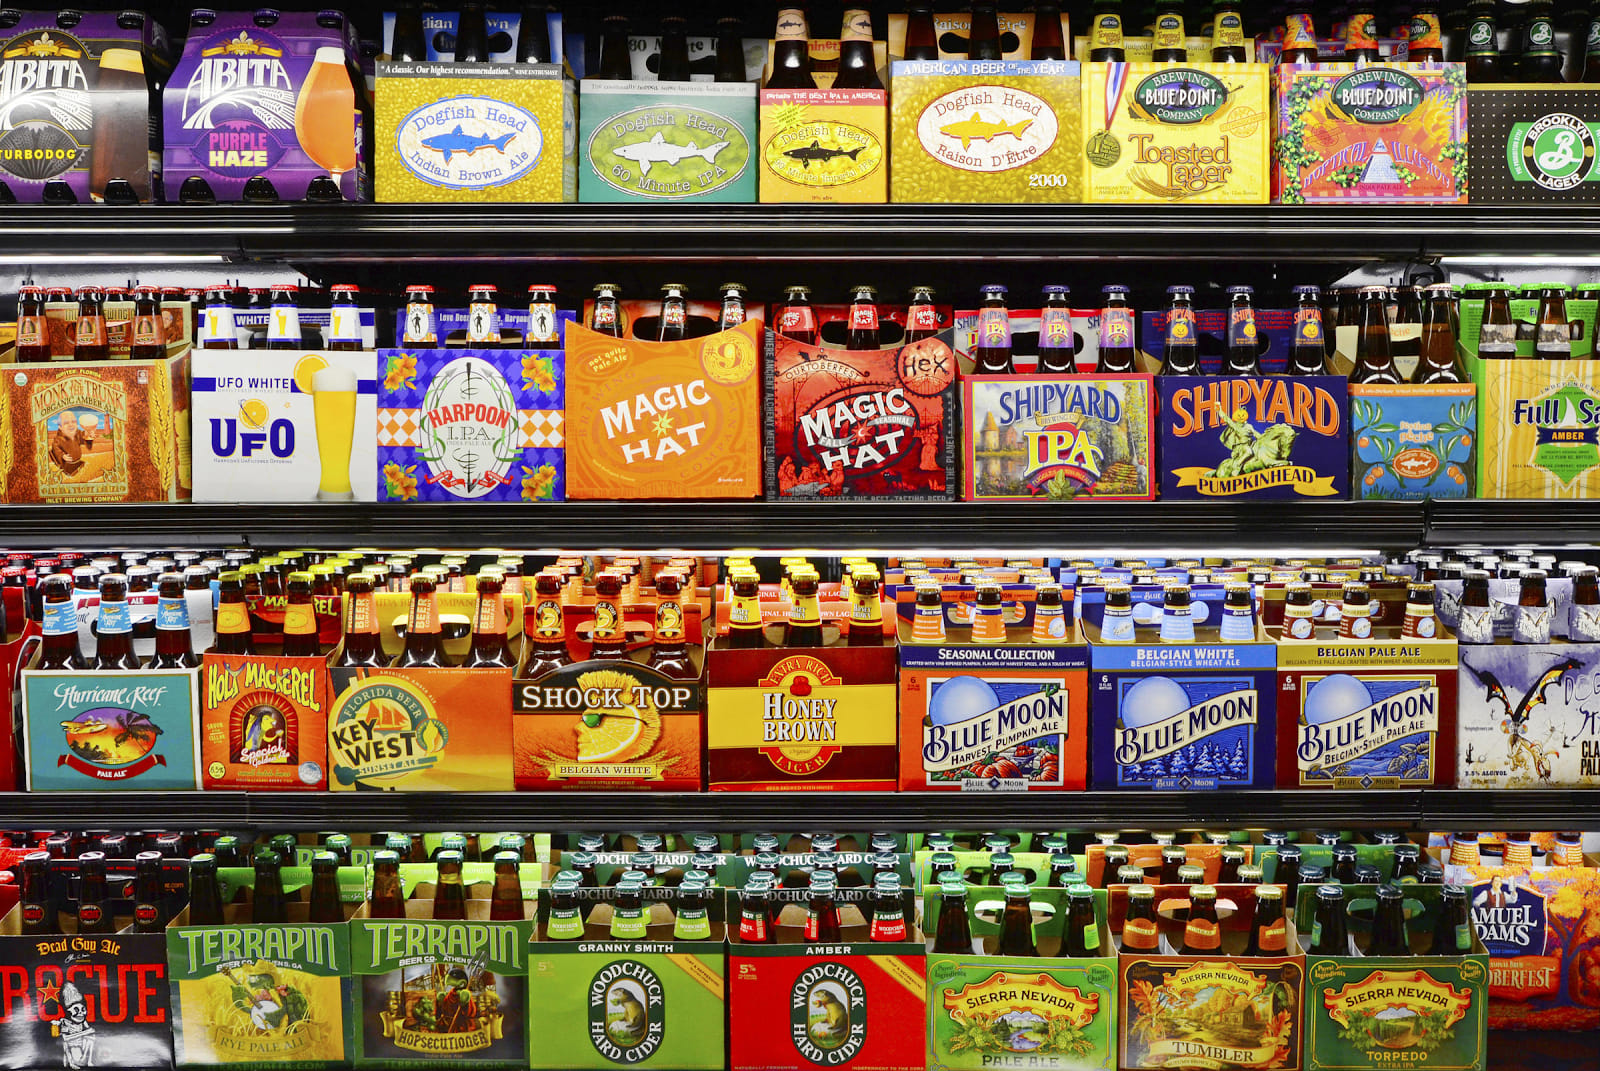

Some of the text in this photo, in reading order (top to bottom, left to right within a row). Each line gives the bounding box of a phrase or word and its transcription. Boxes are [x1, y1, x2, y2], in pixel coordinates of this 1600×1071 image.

[416, 65, 430, 74] Our
[904, 62, 1066, 76] AMERICAN BEER YEAR
[1153, 72, 1209, 87] BREWING
[1349, 72, 1407, 88] BREWING
[793, 91, 808, 99] THE
[809, 91, 826, 100] BEST
[934, 92, 1042, 117] Dogfish Head
[1146, 89, 1217, 106] BLUE POINT
[1342, 89, 1414, 106] BLUE POINT
[412, 106, 527, 133] Dogfish Head
[612, 112, 730, 139] Dogfish Head
[1157, 109, 1203, 120] COMPANY
[1353, 109, 1400, 120] COMPANY
[782, 124, 870, 146] Dogfish Head
[1528, 115, 1589, 142] BROOKLYN
[209, 132, 268, 151] PURPLE
[1128, 134, 1231, 163] Toasted
[209, 150, 268, 167] HAZE
[409, 151, 529, 182] Indian Brown Ale
[936, 144, 982, 167] Raison
[611, 163, 727, 193] 60 Minute IPA
[1028, 173, 1068, 188] 2000
[1163, 161, 1233, 192] Lager
[1537, 172, 1582, 189] LAGER
[218, 377, 290, 389] UFO WHITE
[785, 362, 860, 382] OURTOBERFEST
[765, 330, 775, 454] WHERE ANCIENT ALCHEMY MEETS
[600, 379, 713, 440] MAGIC
[1000, 383, 1122, 425] SHIPYARD
[1171, 379, 1341, 438] SHIPYARD
[1512, 399, 1559, 426] Full
[427, 403, 512, 430] HARPOON
[800, 388, 911, 447] MAGIC
[209, 418, 296, 459] UFO
[448, 426, 497, 441] I.P.A.
[620, 421, 706, 464] HAT
[1551, 432, 1585, 441] AMBER
[819, 429, 905, 476] HAT
[1024, 430, 1105, 479] IPA
[1198, 468, 1315, 495] PUMPKINHEAD
[94, 496, 122, 504] COMPANY
[938, 648, 1055, 661] SEASONAL COLLECTION
[1136, 648, 1236, 660] BELGIAN WHITE
[1317, 646, 1421, 658] BELGIAN PALE ALE
[769, 659, 833, 685] EXTRA RICH
[1130, 660, 1193, 668] BELGIAN-STYLE
[1195, 660, 1223, 668] WHEAT
[208, 662, 322, 713] HOLY MACKEREL
[910, 677, 917, 685] 6
[1102, 676, 1109, 684] 6
[1286, 675, 1292, 683] 6
[350, 687, 423, 719] FLORIDA BEER
[522, 686, 623, 708] SHOCK
[762, 693, 838, 721] HONEY
[332, 718, 378, 750] KEY
[763, 720, 837, 742] BROWN
[922, 693, 1064, 764] BLUE MOON
[1116, 695, 1255, 765] BLUE MOON
[1298, 692, 1434, 762] BLUE MOON
[240, 738, 284, 764] Special
[344, 732, 417, 767] WEST
[951, 721, 1060, 770] HARVEST PUMPKIN ALE
[1324, 720, 1425, 765] BELGIAN-STYLE PALE ALE
[97, 770, 128, 779] PALE ALE
[559, 766, 653, 775] BELGIAN WHITE
[776, 756, 826, 773] LAGER
[966, 779, 1024, 788] BLUE MOON
[1156, 779, 1214, 788] BLUE MOON
[1338, 778, 1395, 787] BLUE MOON
[36, 937, 121, 956] Dead Guy Ale
[178, 927, 339, 975] TERRAPIN
[362, 922, 522, 970] TERRAPIN
[578, 943, 674, 953] GRANNY SMITH
[806, 947, 852, 957] AMBER
[215, 960, 242, 972] BEER
[398, 956, 423, 967] BEER
[739, 964, 756, 974] 5%
[591, 962, 662, 1008] WOODCHUCK
[793, 963, 864, 1010] WOODCHUCK
[1180, 971, 1250, 987] SIERRA NEVADA
[0, 964, 165, 1023] ROGUE
[966, 989, 1076, 1013] SIERRA NEVADA
[1345, 987, 1450, 1009] SIERRA NEVADA
[220, 1036, 307, 1054] RYE PALE ALE
[398, 1030, 489, 1052] HOPSECUTIONER
[591, 1021, 662, 1063] HARD CIDER
[793, 1023, 864, 1064] HARD CIDER
[982, 1054, 1060, 1068] PALE ALE
[1172, 1041, 1254, 1064] TUMBLER
[1366, 1051, 1429, 1063] TORPEDO
